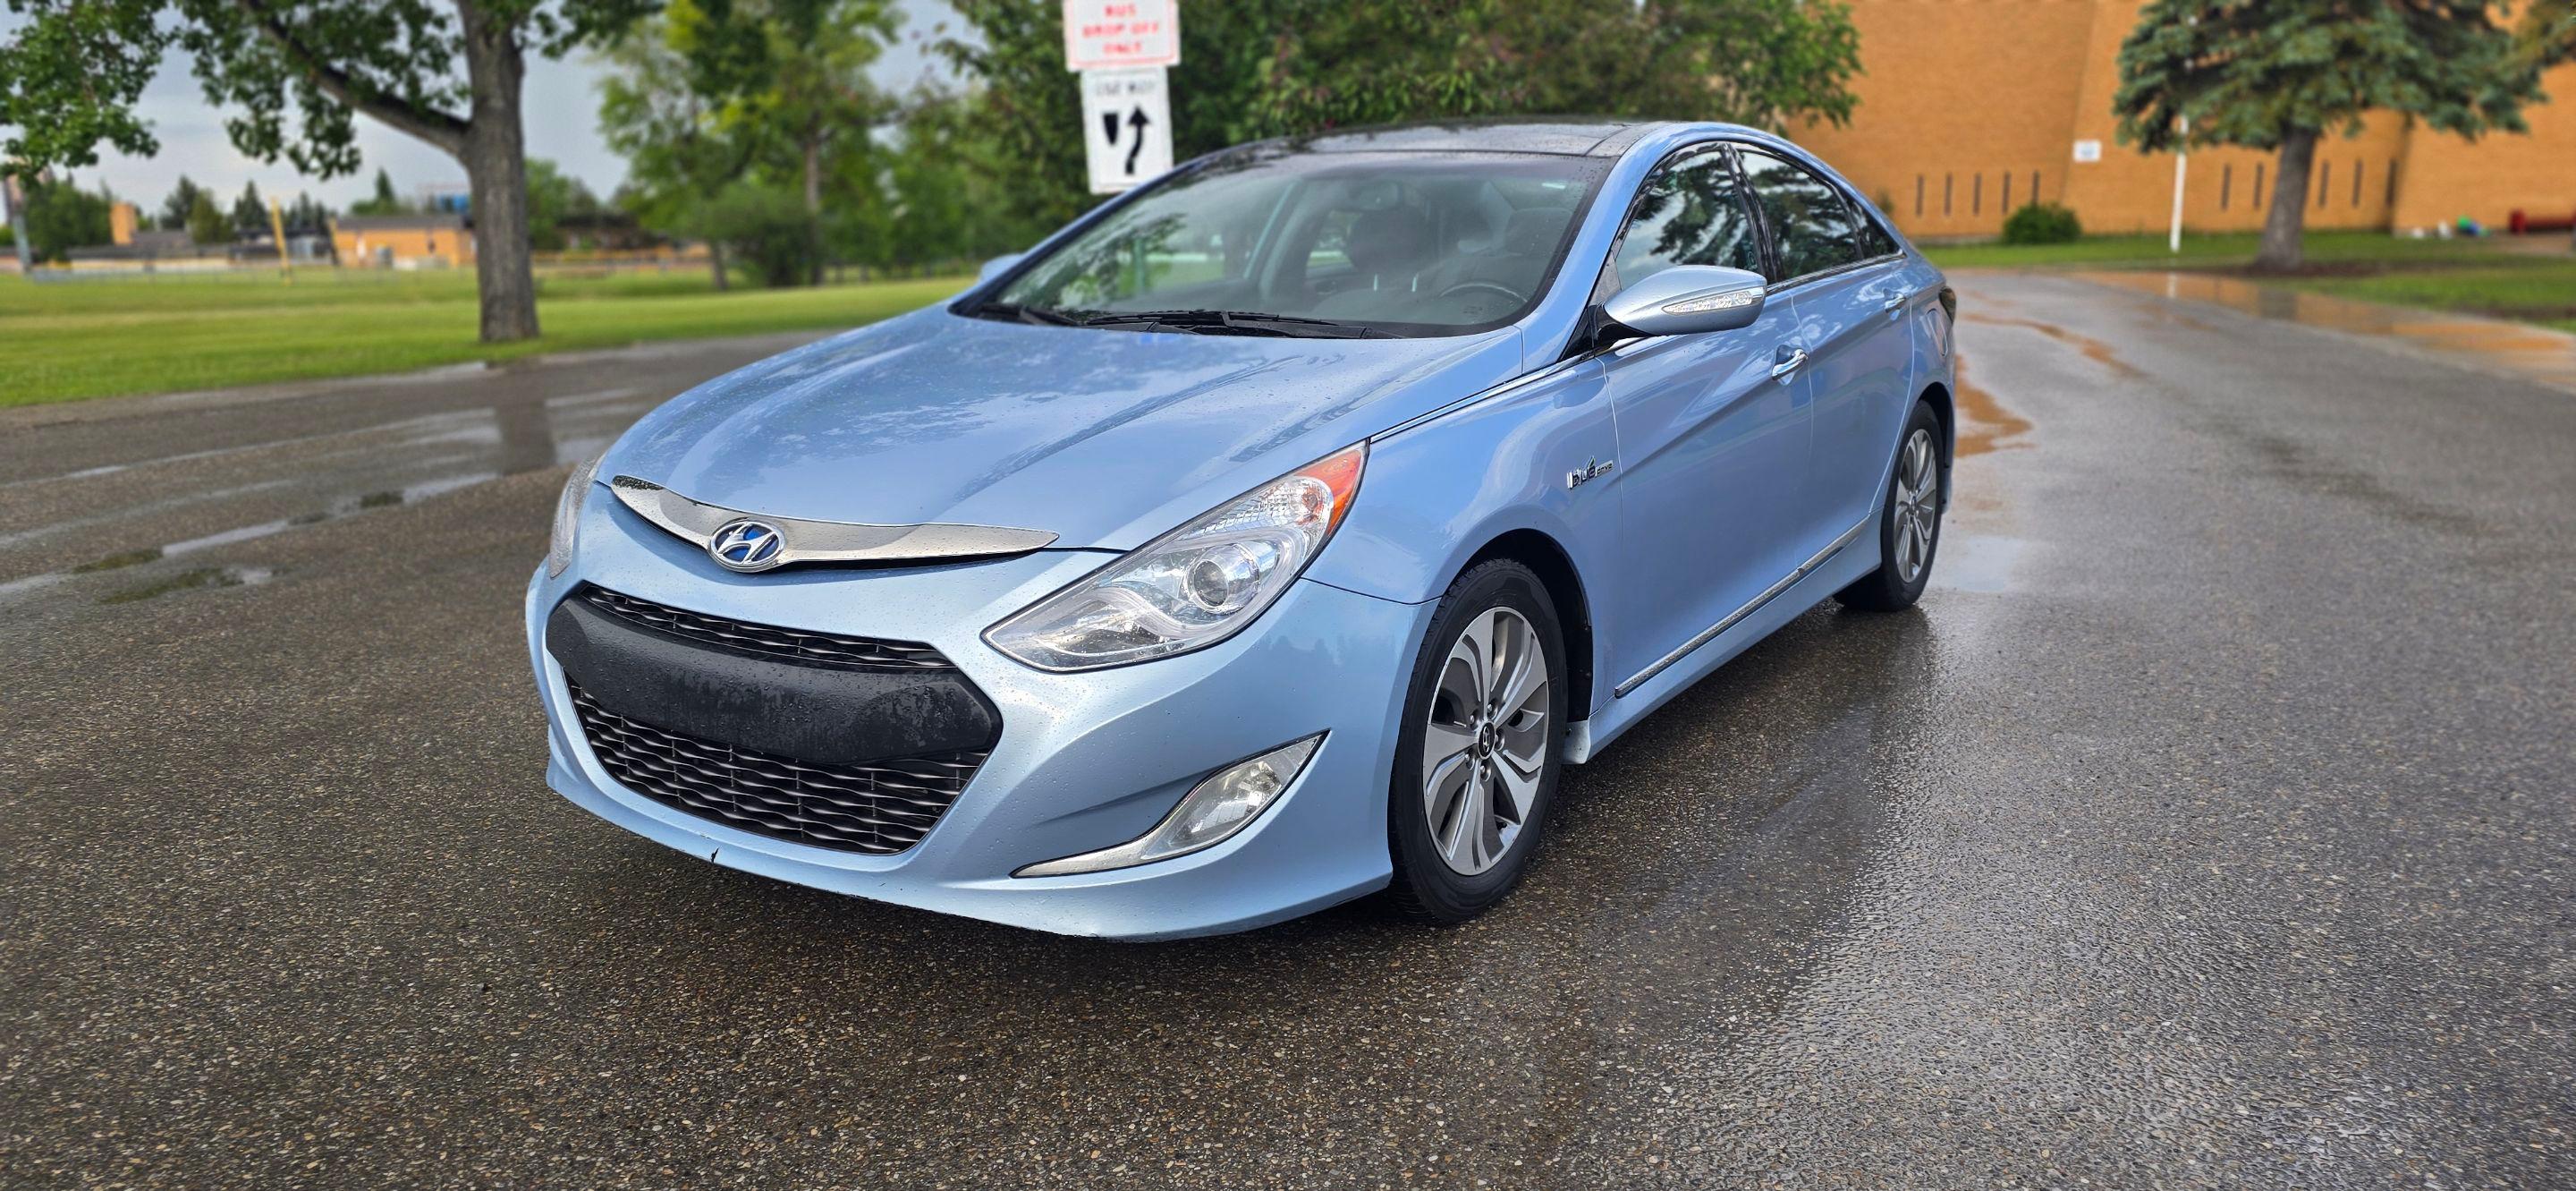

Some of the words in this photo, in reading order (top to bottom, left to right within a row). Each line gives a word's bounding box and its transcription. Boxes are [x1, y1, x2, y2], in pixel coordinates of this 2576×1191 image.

[1105, 4, 1136, 17] BUS
[1082, 24, 1124, 38] DROP
[1131, 22, 1158, 34] OFF
[1103, 42, 1141, 54] ONLY
